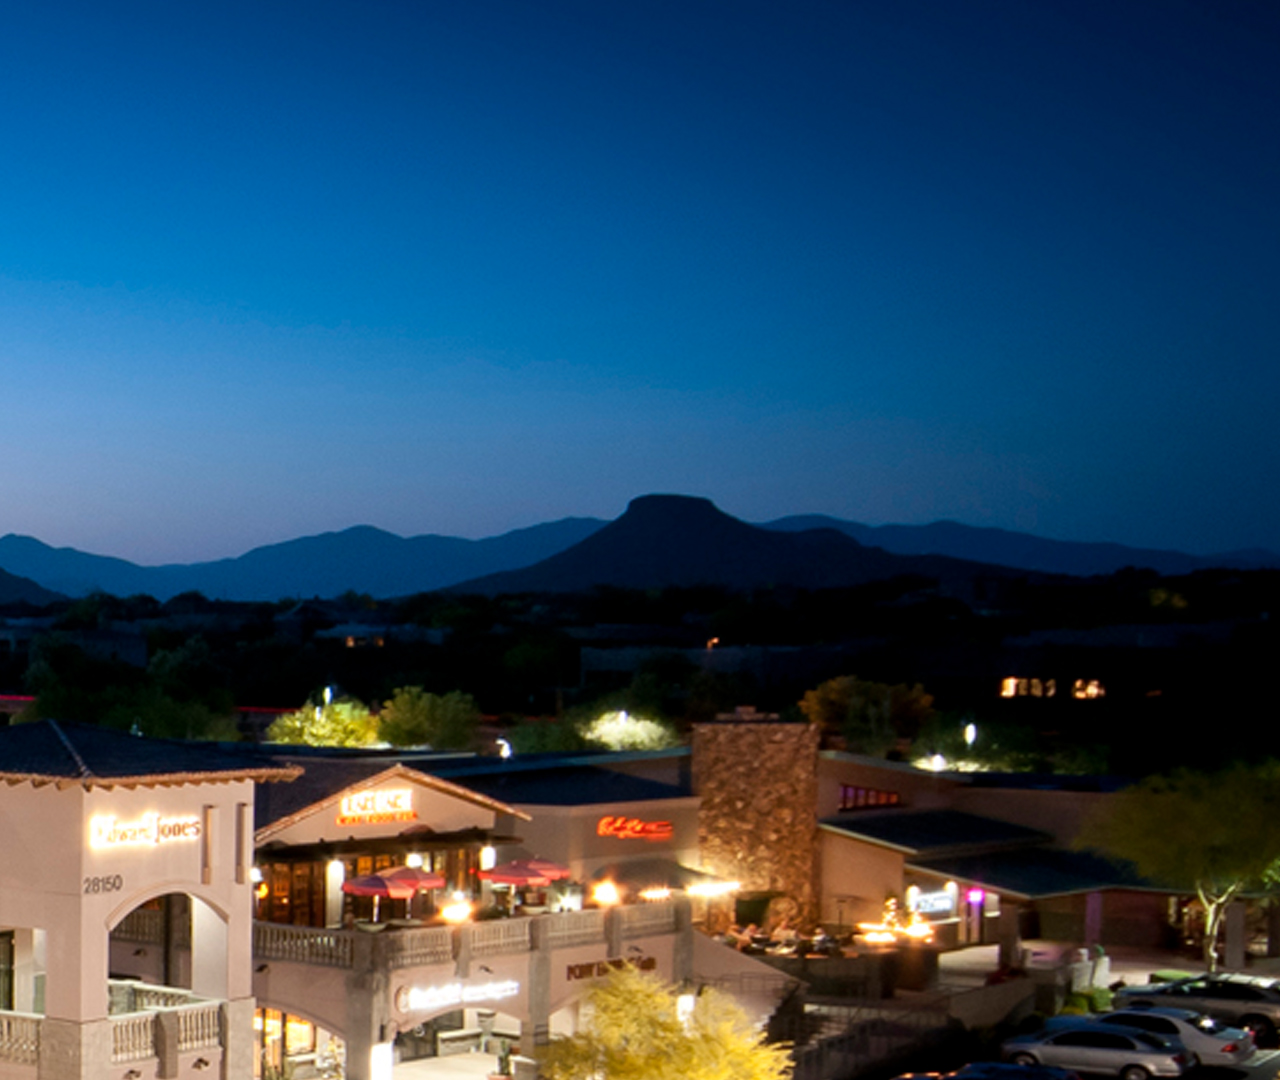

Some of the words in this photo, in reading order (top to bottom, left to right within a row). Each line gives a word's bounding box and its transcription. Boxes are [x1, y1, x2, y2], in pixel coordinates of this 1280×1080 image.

[95, 813, 153, 844] dward
[153, 815, 201, 843] Jones
[84, 875, 123, 894] 28150
